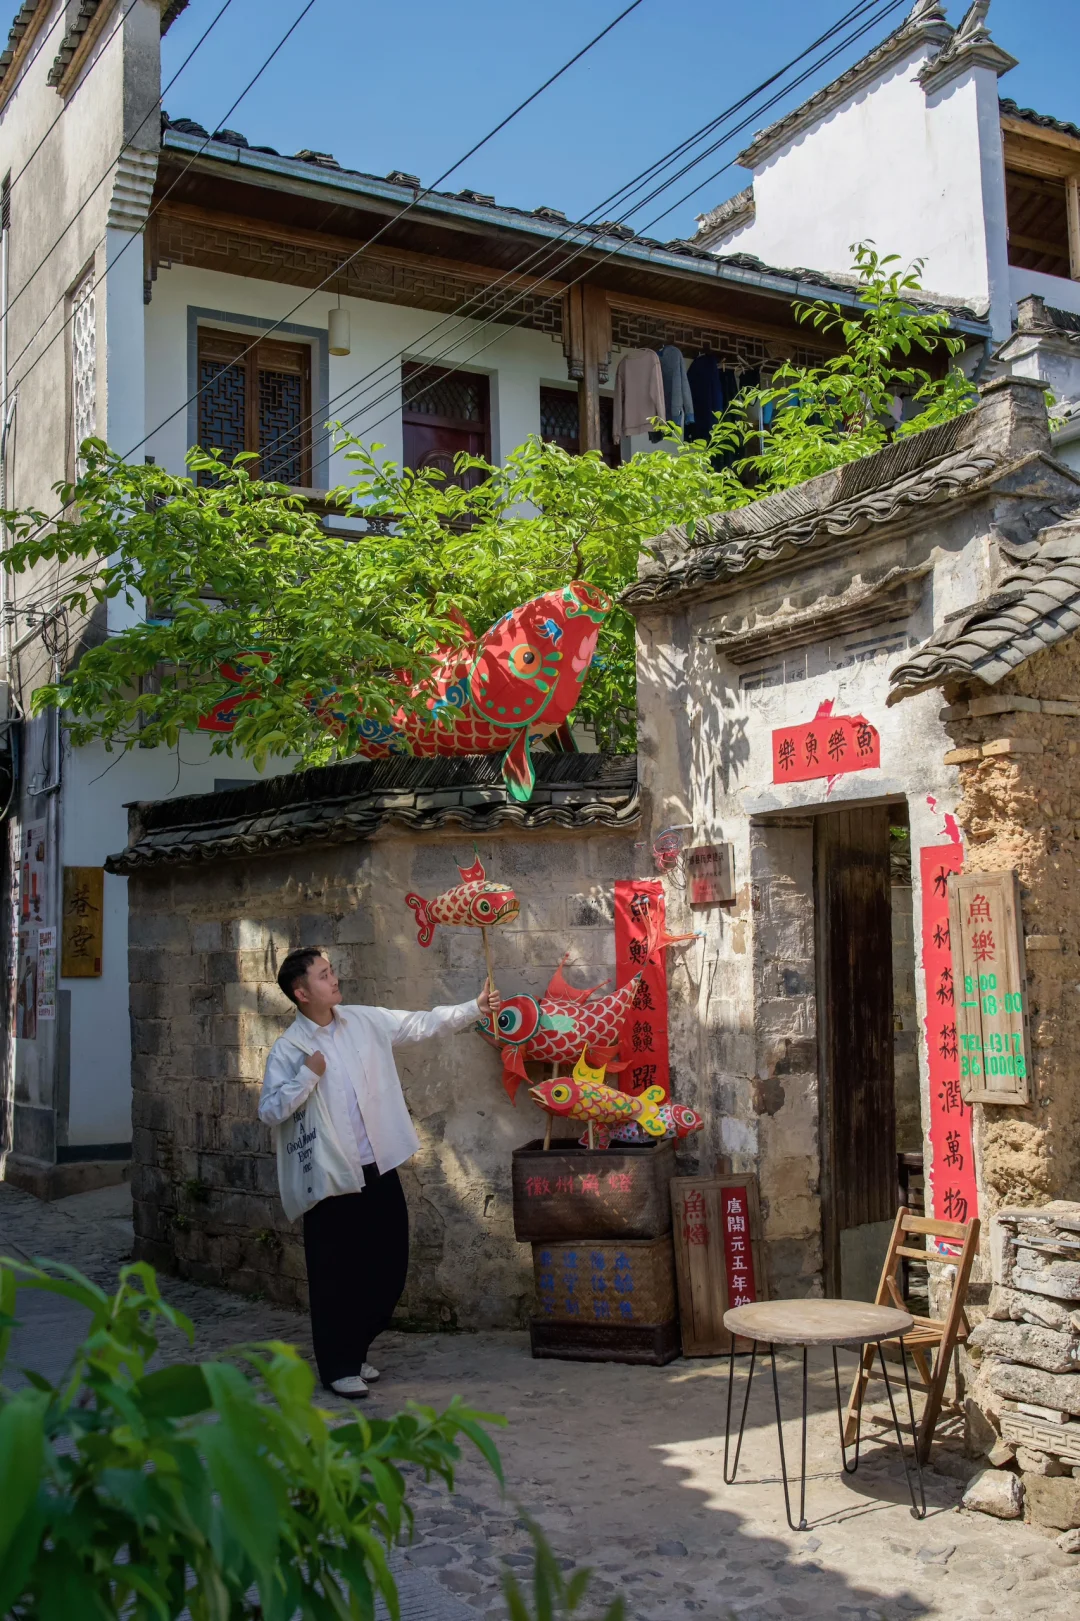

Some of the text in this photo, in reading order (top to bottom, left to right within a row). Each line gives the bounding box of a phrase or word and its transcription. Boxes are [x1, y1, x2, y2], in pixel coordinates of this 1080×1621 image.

[968, 893, 995, 962] 魚樂
[965, 973, 997, 993] 8:00
[300, 1123, 305, 1134] A
[683, 1189, 710, 1245] 魚燈
